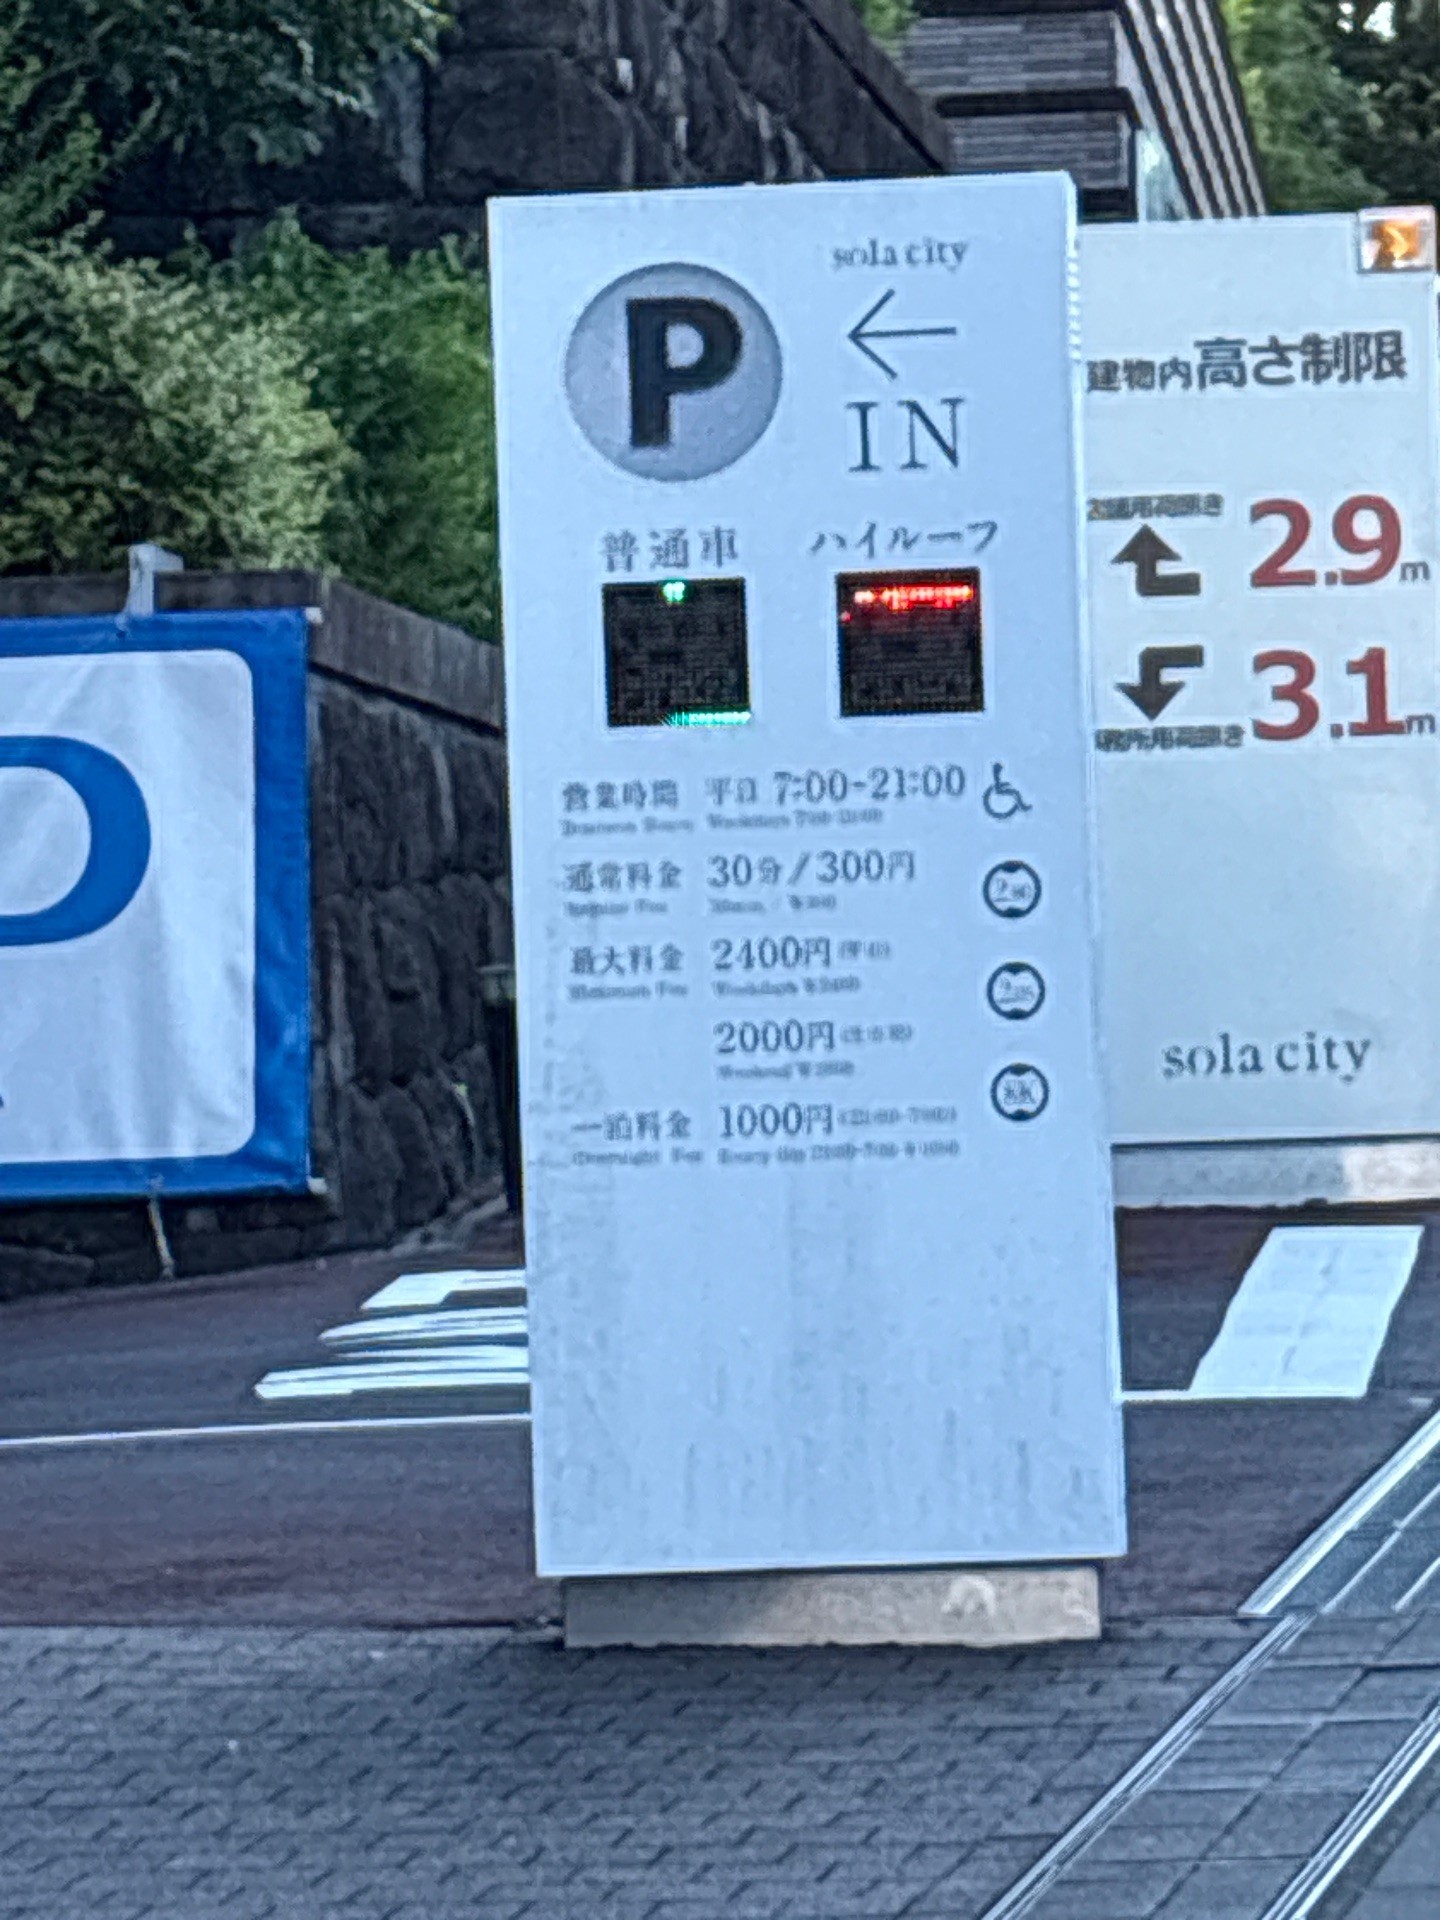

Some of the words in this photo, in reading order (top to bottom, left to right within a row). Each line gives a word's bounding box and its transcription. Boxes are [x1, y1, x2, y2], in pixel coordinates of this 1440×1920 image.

[832, 238, 898, 270] sola
[905, 237, 968, 273] city
[625, 296, 743, 449] P
[1087, 330, 1408, 393] 建物内高さ制限
[846, 397, 965, 472] IN
[603, 525, 740, 571] 普通車
[810, 520, 999, 559] ハイルーフ
[562, 779, 679, 813] 営業時間
[773, 764, 967, 806] 7:00-21:00
[564, 860, 682, 892] 通常料金
[571, 943, 684, 976] 最大料金
[1162, 1033, 1263, 1078] sola
[1275, 1030, 1372, 1084] city
